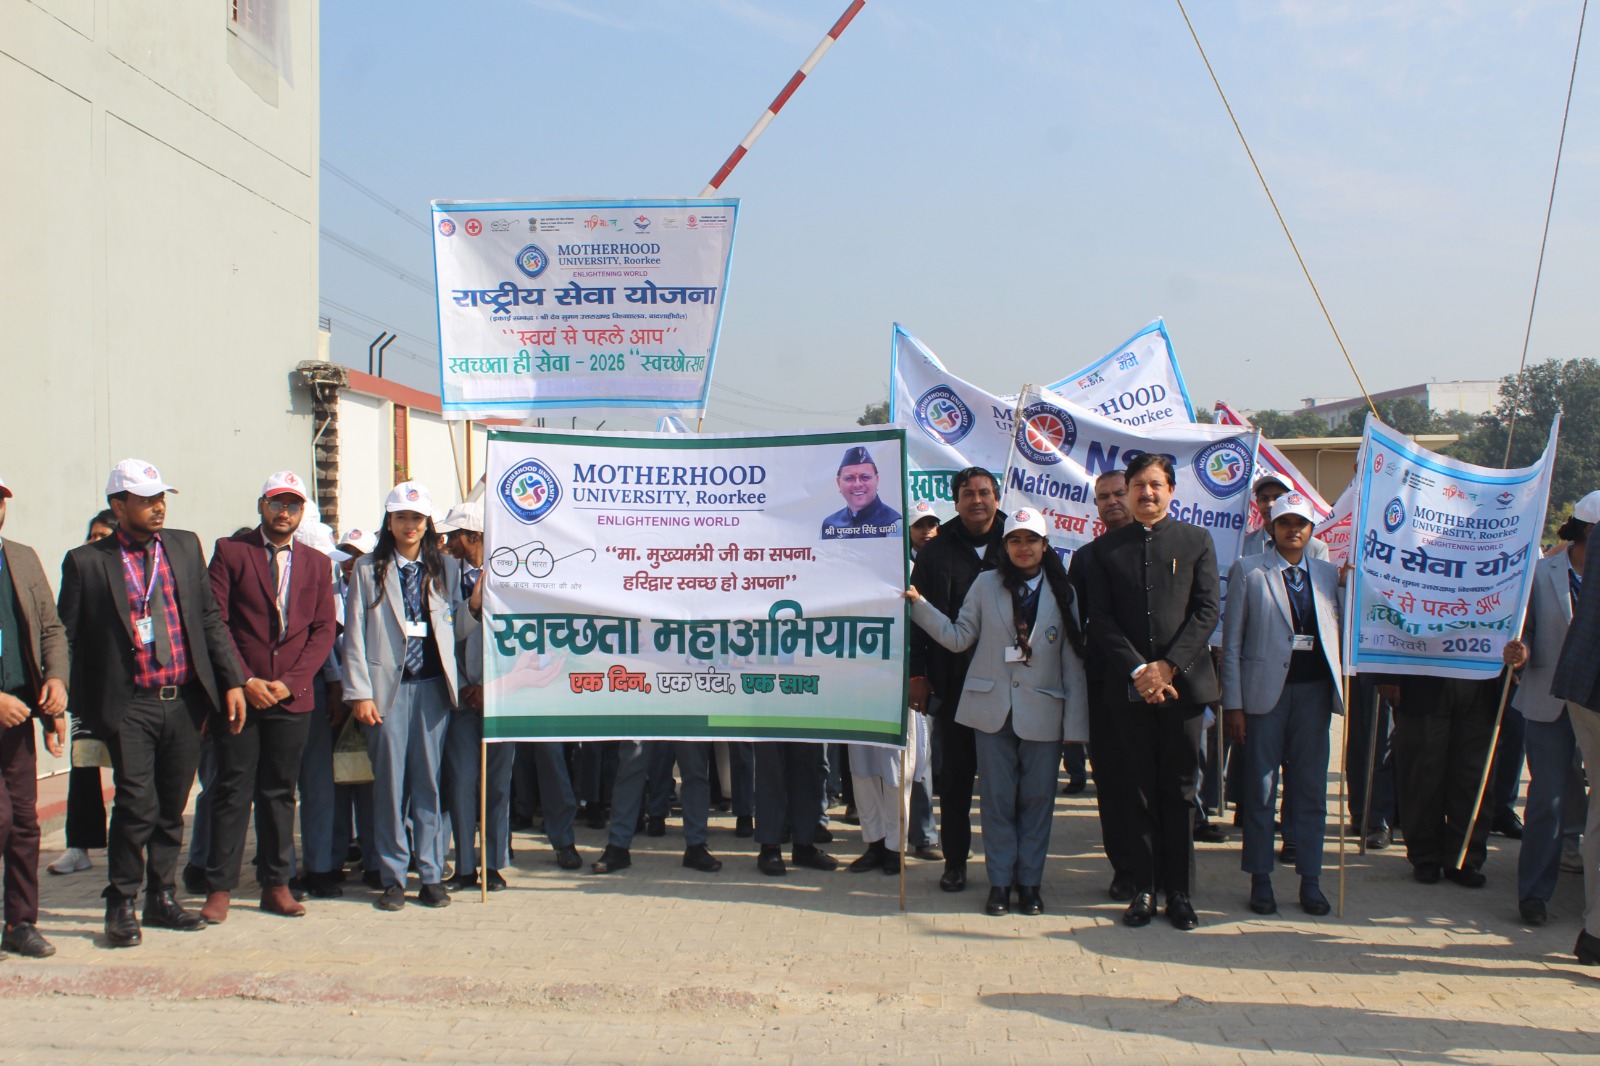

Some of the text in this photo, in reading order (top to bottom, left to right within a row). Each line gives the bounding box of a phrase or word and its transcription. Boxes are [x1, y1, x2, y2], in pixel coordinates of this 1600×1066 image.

[557, 243, 661, 256] MOTHERHOOD
[558, 256, 661, 266] UNIVERSITY, Roorkee
[451, 279, 718, 314] राष्ट्रीय सेवा योजना
[561, 325, 578, 345] से
[582, 325, 624, 346] पहले
[448, 356, 508, 374] स्वच्छता
[513, 349, 531, 375] ही
[535, 349, 570, 372] सेवा
[590, 353, 625, 371] 2026
[920, 392, 950, 419] MOTHERHOOD
[950, 394, 968, 428] UNIVERSITY
[1199, 442, 1236, 469] MOTHERHOOD
[505, 466, 555, 502] MOTHERHOOD UNIVERSITY
[572, 463, 766, 486] MOTHERHOOD
[573, 488, 766, 507] UNIVERSITY, Roorkee
[597, 515, 740, 527] ENLIGHTENING WORLD
[1414, 506, 1519, 530] MOTHERHOOD
[824, 525, 835, 536] श्री
[862, 523, 877, 535] सिंह
[1412, 519, 1518, 541] UNIVERSITY, Roorkee
[1421, 537, 1503, 551] ENLIGHTENING WORLD
[496, 559, 513, 567] स्वच्छ
[532, 560, 548, 568] भारत
[605, 542, 816, 569] “मा. मुख्यमंत्री जी का सपना,
[1400, 546, 1467, 578] सेवा
[532, 582, 556, 590] स्वच्छता
[558, 582, 567, 590] की
[570, 582, 583, 591] ओर
[623, 570, 797, 592] हरिद्वार स्वच्छ हो अपना”
[1397, 592, 1416, 614] से
[1421, 598, 1471, 618] पहले
[492, 599, 895, 660] स्वच्छता महाअभियान
[1442, 637, 1492, 654] 2026
[569, 664, 820, 695] एक दिन, एक घंटा, एक साथ
